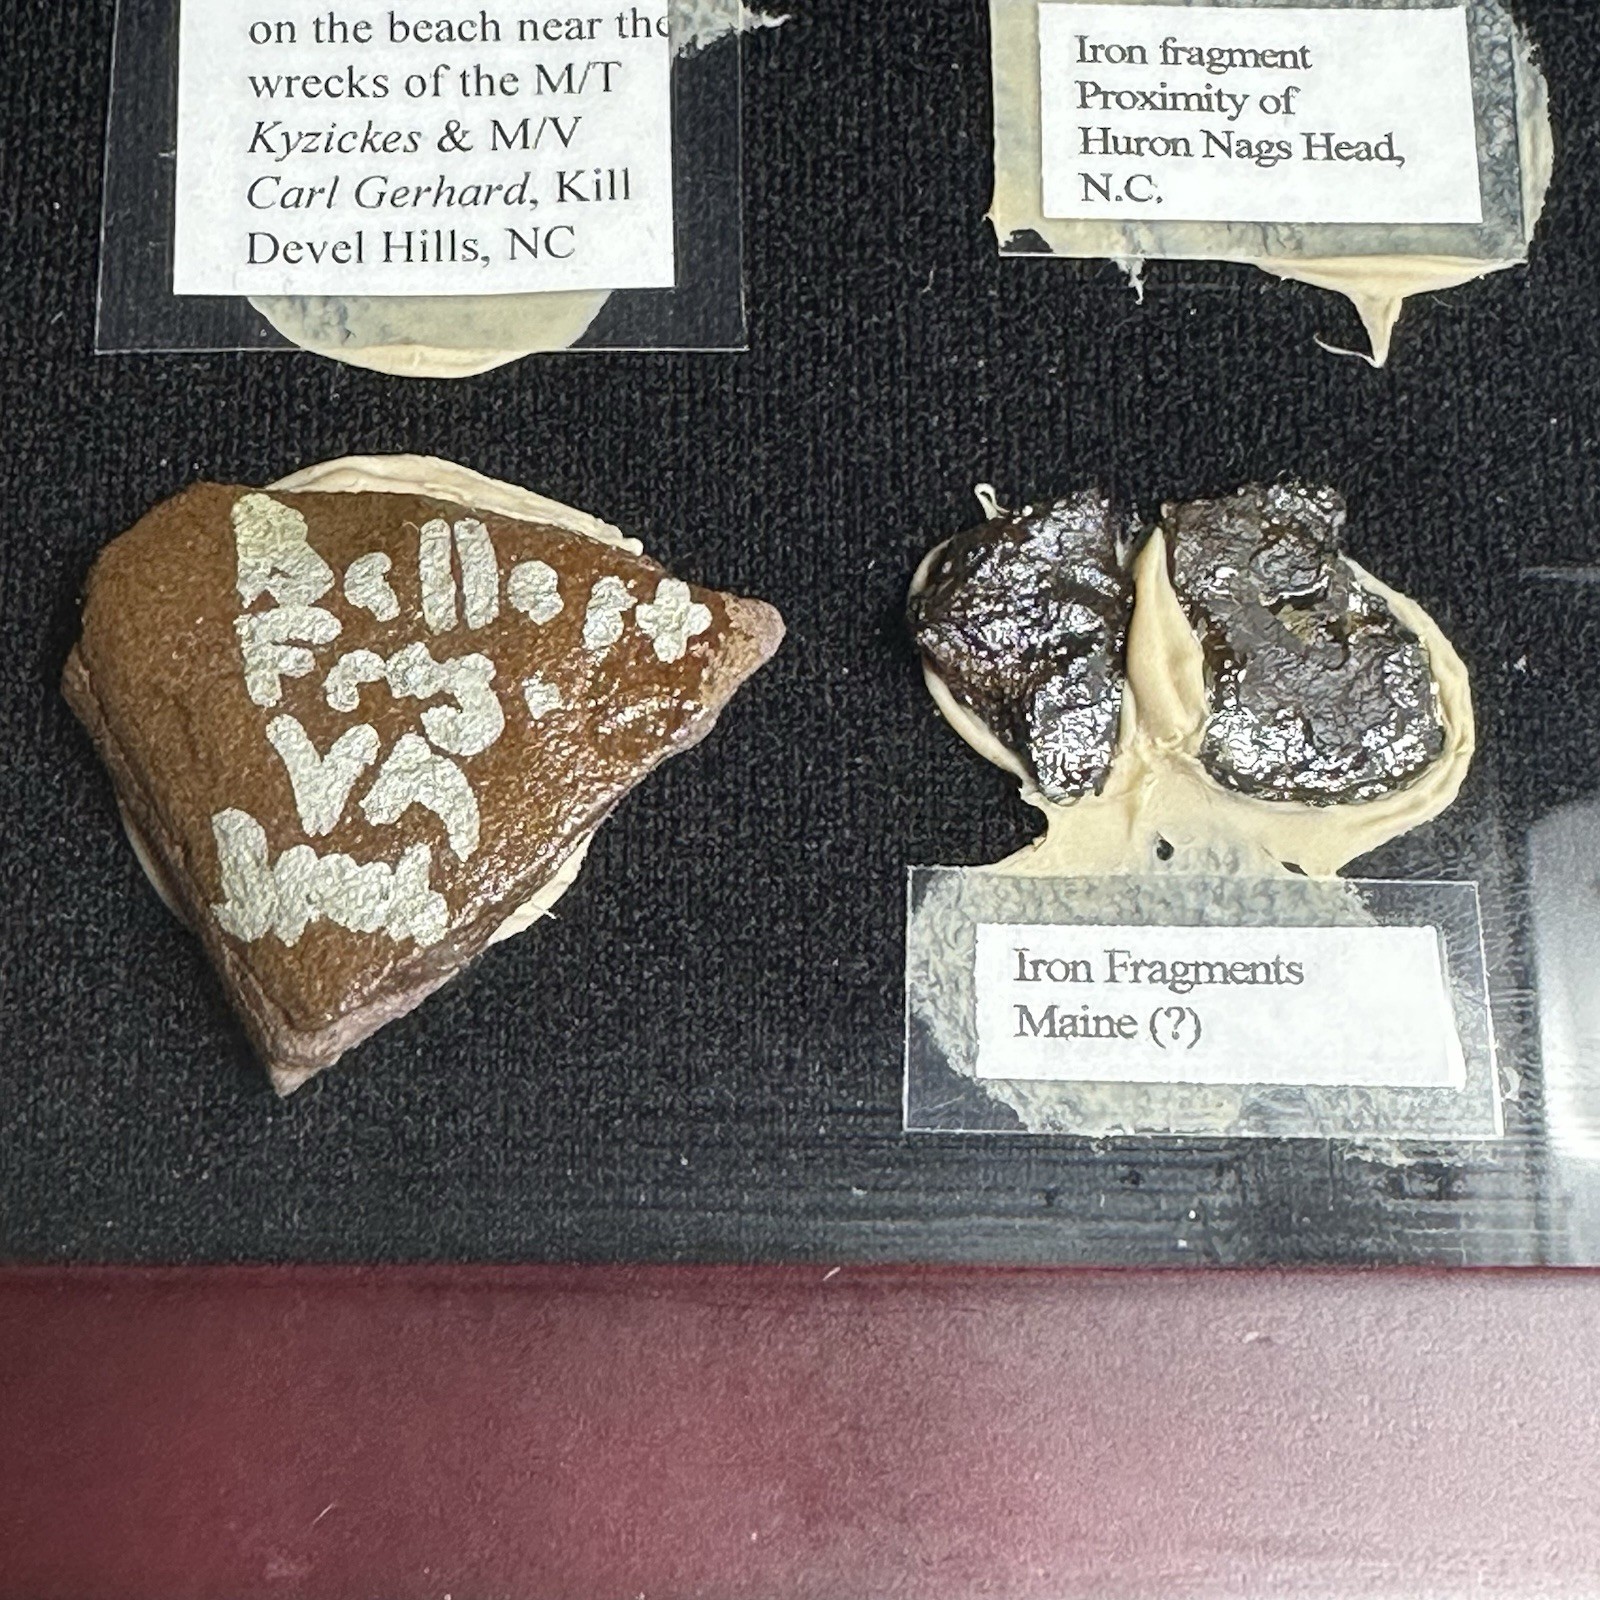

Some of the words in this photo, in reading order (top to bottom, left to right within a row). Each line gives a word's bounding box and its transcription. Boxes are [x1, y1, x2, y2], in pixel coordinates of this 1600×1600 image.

[249, 21, 297, 45] on
[312, 11, 372, 44] the
[388, 10, 501, 43] beach
[518, 18, 603, 42] near
[1075, 35, 1149, 65] Iron
[1160, 36, 1313, 76] fragment
[248, 64, 389, 99] wrecks
[404, 63, 448, 98] of
[459, 63, 519, 97] the
[535, 61, 622, 95] M/T
[1074, 80, 1250, 122] Proximity
[1259, 85, 1301, 115] of
[247, 120, 422, 162] Kyzickes
[437, 119, 474, 153] &
[491, 116, 583, 151] M/V
[1078, 126, 1193, 158] Huron
[1199, 129, 1293, 168] Nags
[1300, 132, 1405, 168] Head,
[247, 175, 340, 210] Carl
[354, 171, 539, 212] Gerhard,
[556, 167, 630, 203] Kill
[247, 230, 363, 265] Devel
[382, 229, 491, 268] Hills,
[506, 225, 575, 261] NC
[1012, 948, 1095, 983] Iron
[1104, 949, 1305, 994] Fragments
[1012, 1004, 1138, 1039] Maine
[1148, 1006, 1202, 1049] (?)
